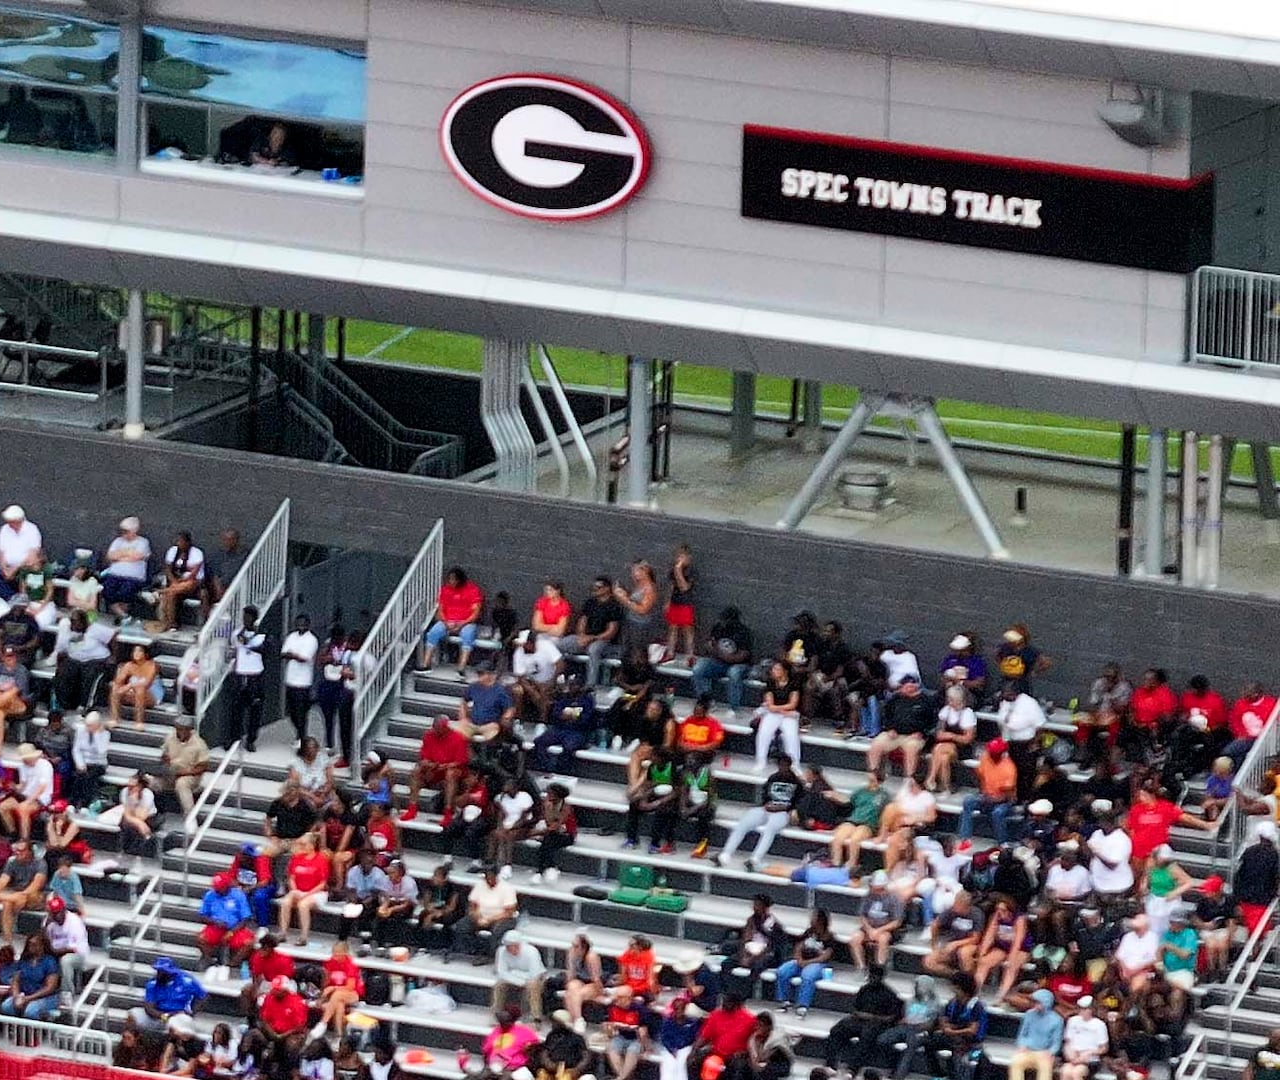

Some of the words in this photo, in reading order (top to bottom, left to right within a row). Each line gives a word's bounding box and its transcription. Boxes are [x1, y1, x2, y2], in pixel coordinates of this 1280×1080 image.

[781, 168, 849, 203] SPEC
[854, 177, 947, 216] TOWNS
[952, 189, 1042, 228] TRACK
